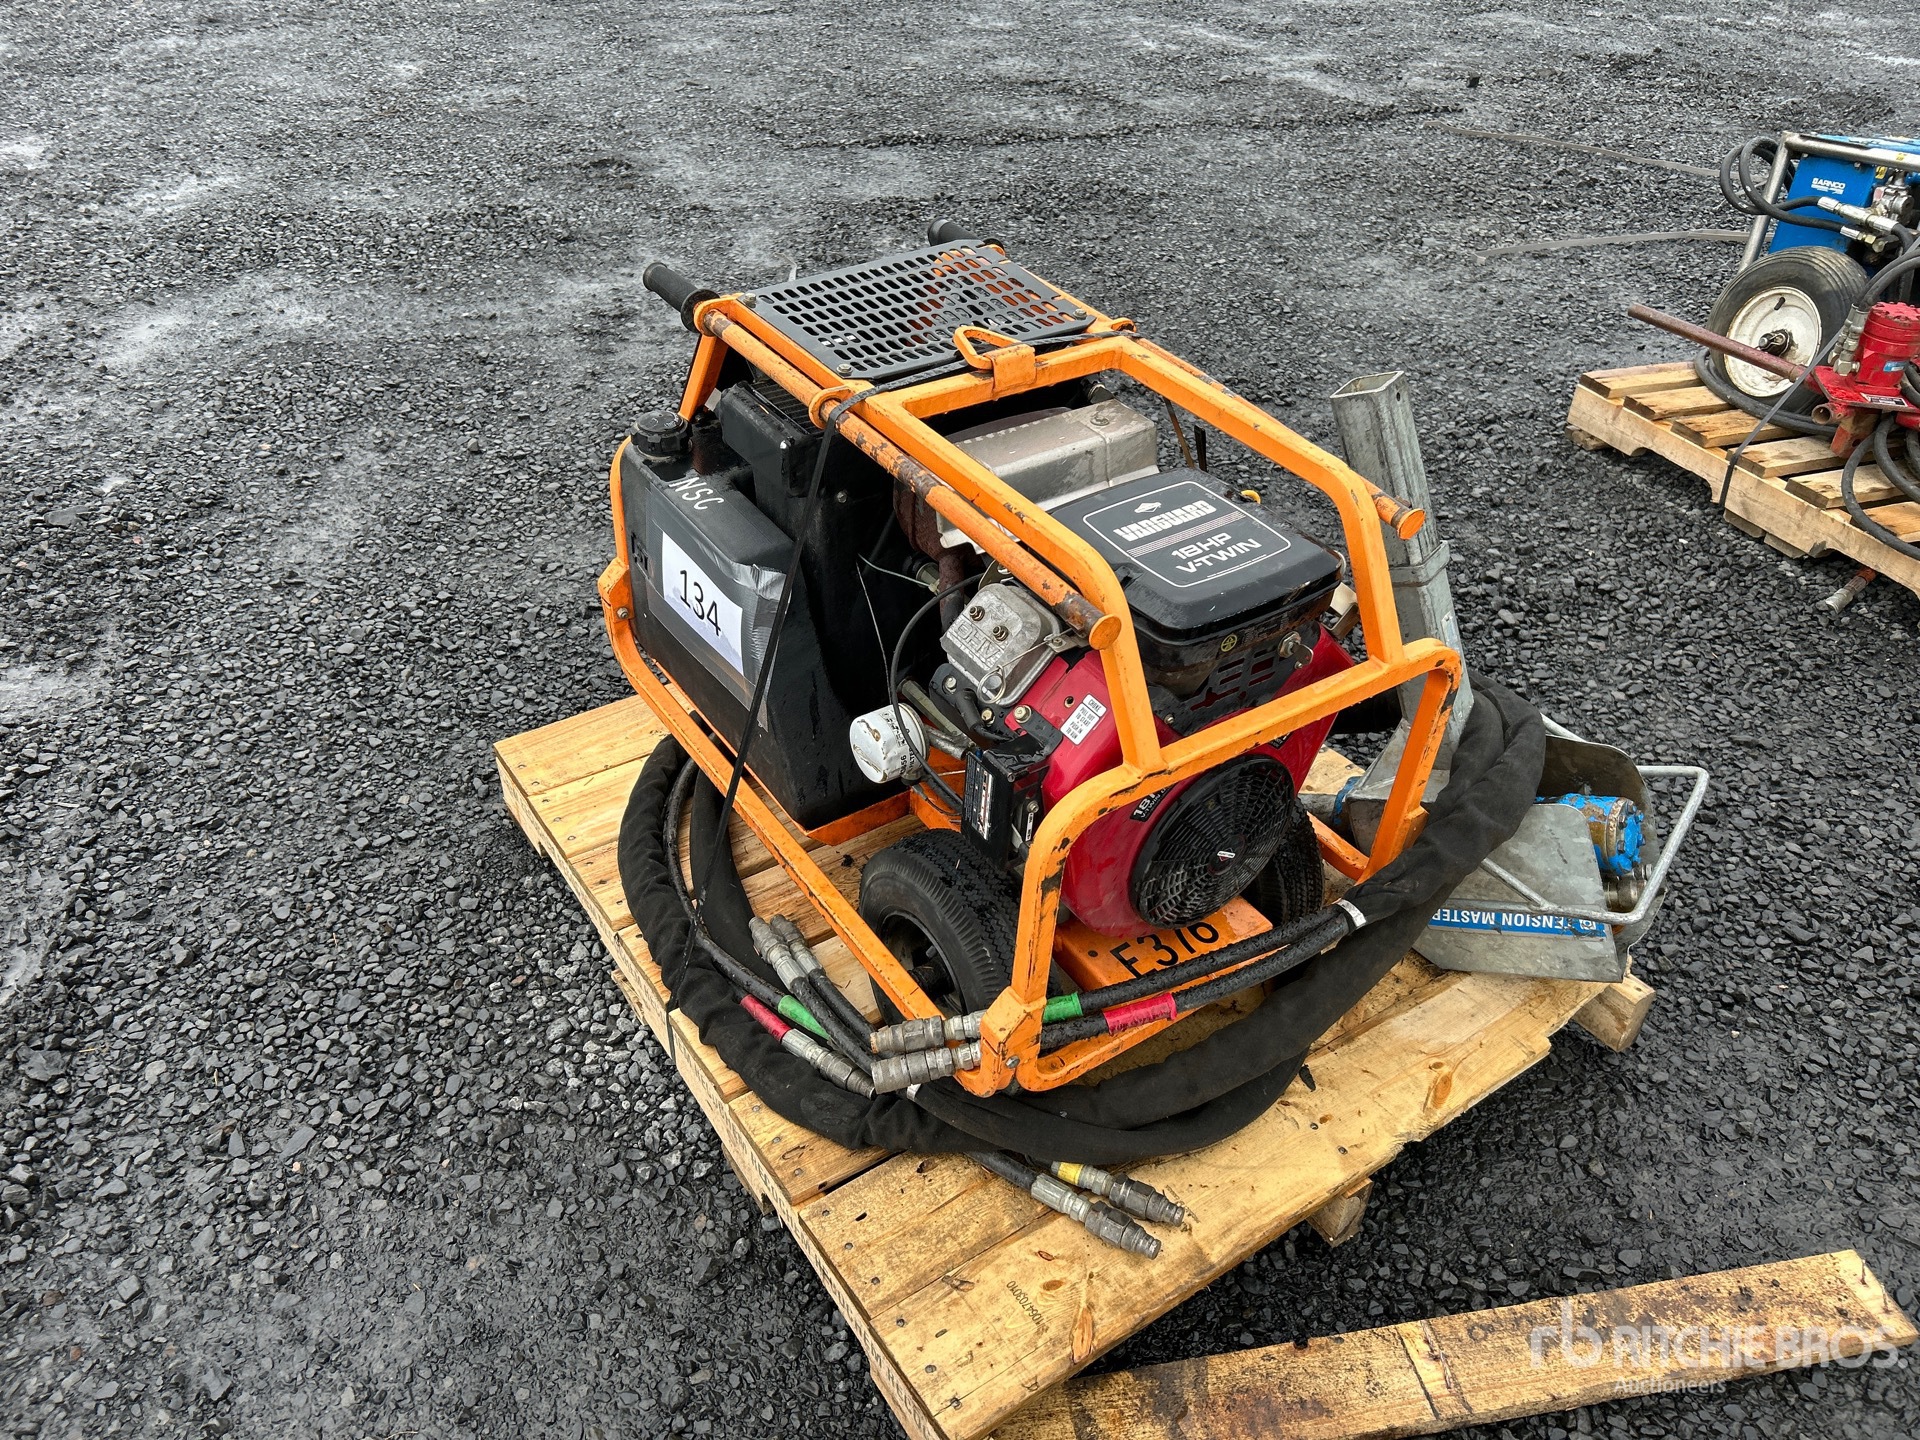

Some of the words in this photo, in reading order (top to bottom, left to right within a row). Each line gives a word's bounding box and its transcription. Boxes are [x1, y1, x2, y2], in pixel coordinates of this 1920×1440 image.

[668, 476, 725, 510] NSC
[1113, 500, 1217, 542] VANGUARD
[1175, 538, 1262, 573] V-TWIN
[679, 569, 722, 636] 134
[1502, 912, 1573, 930] TENSION
